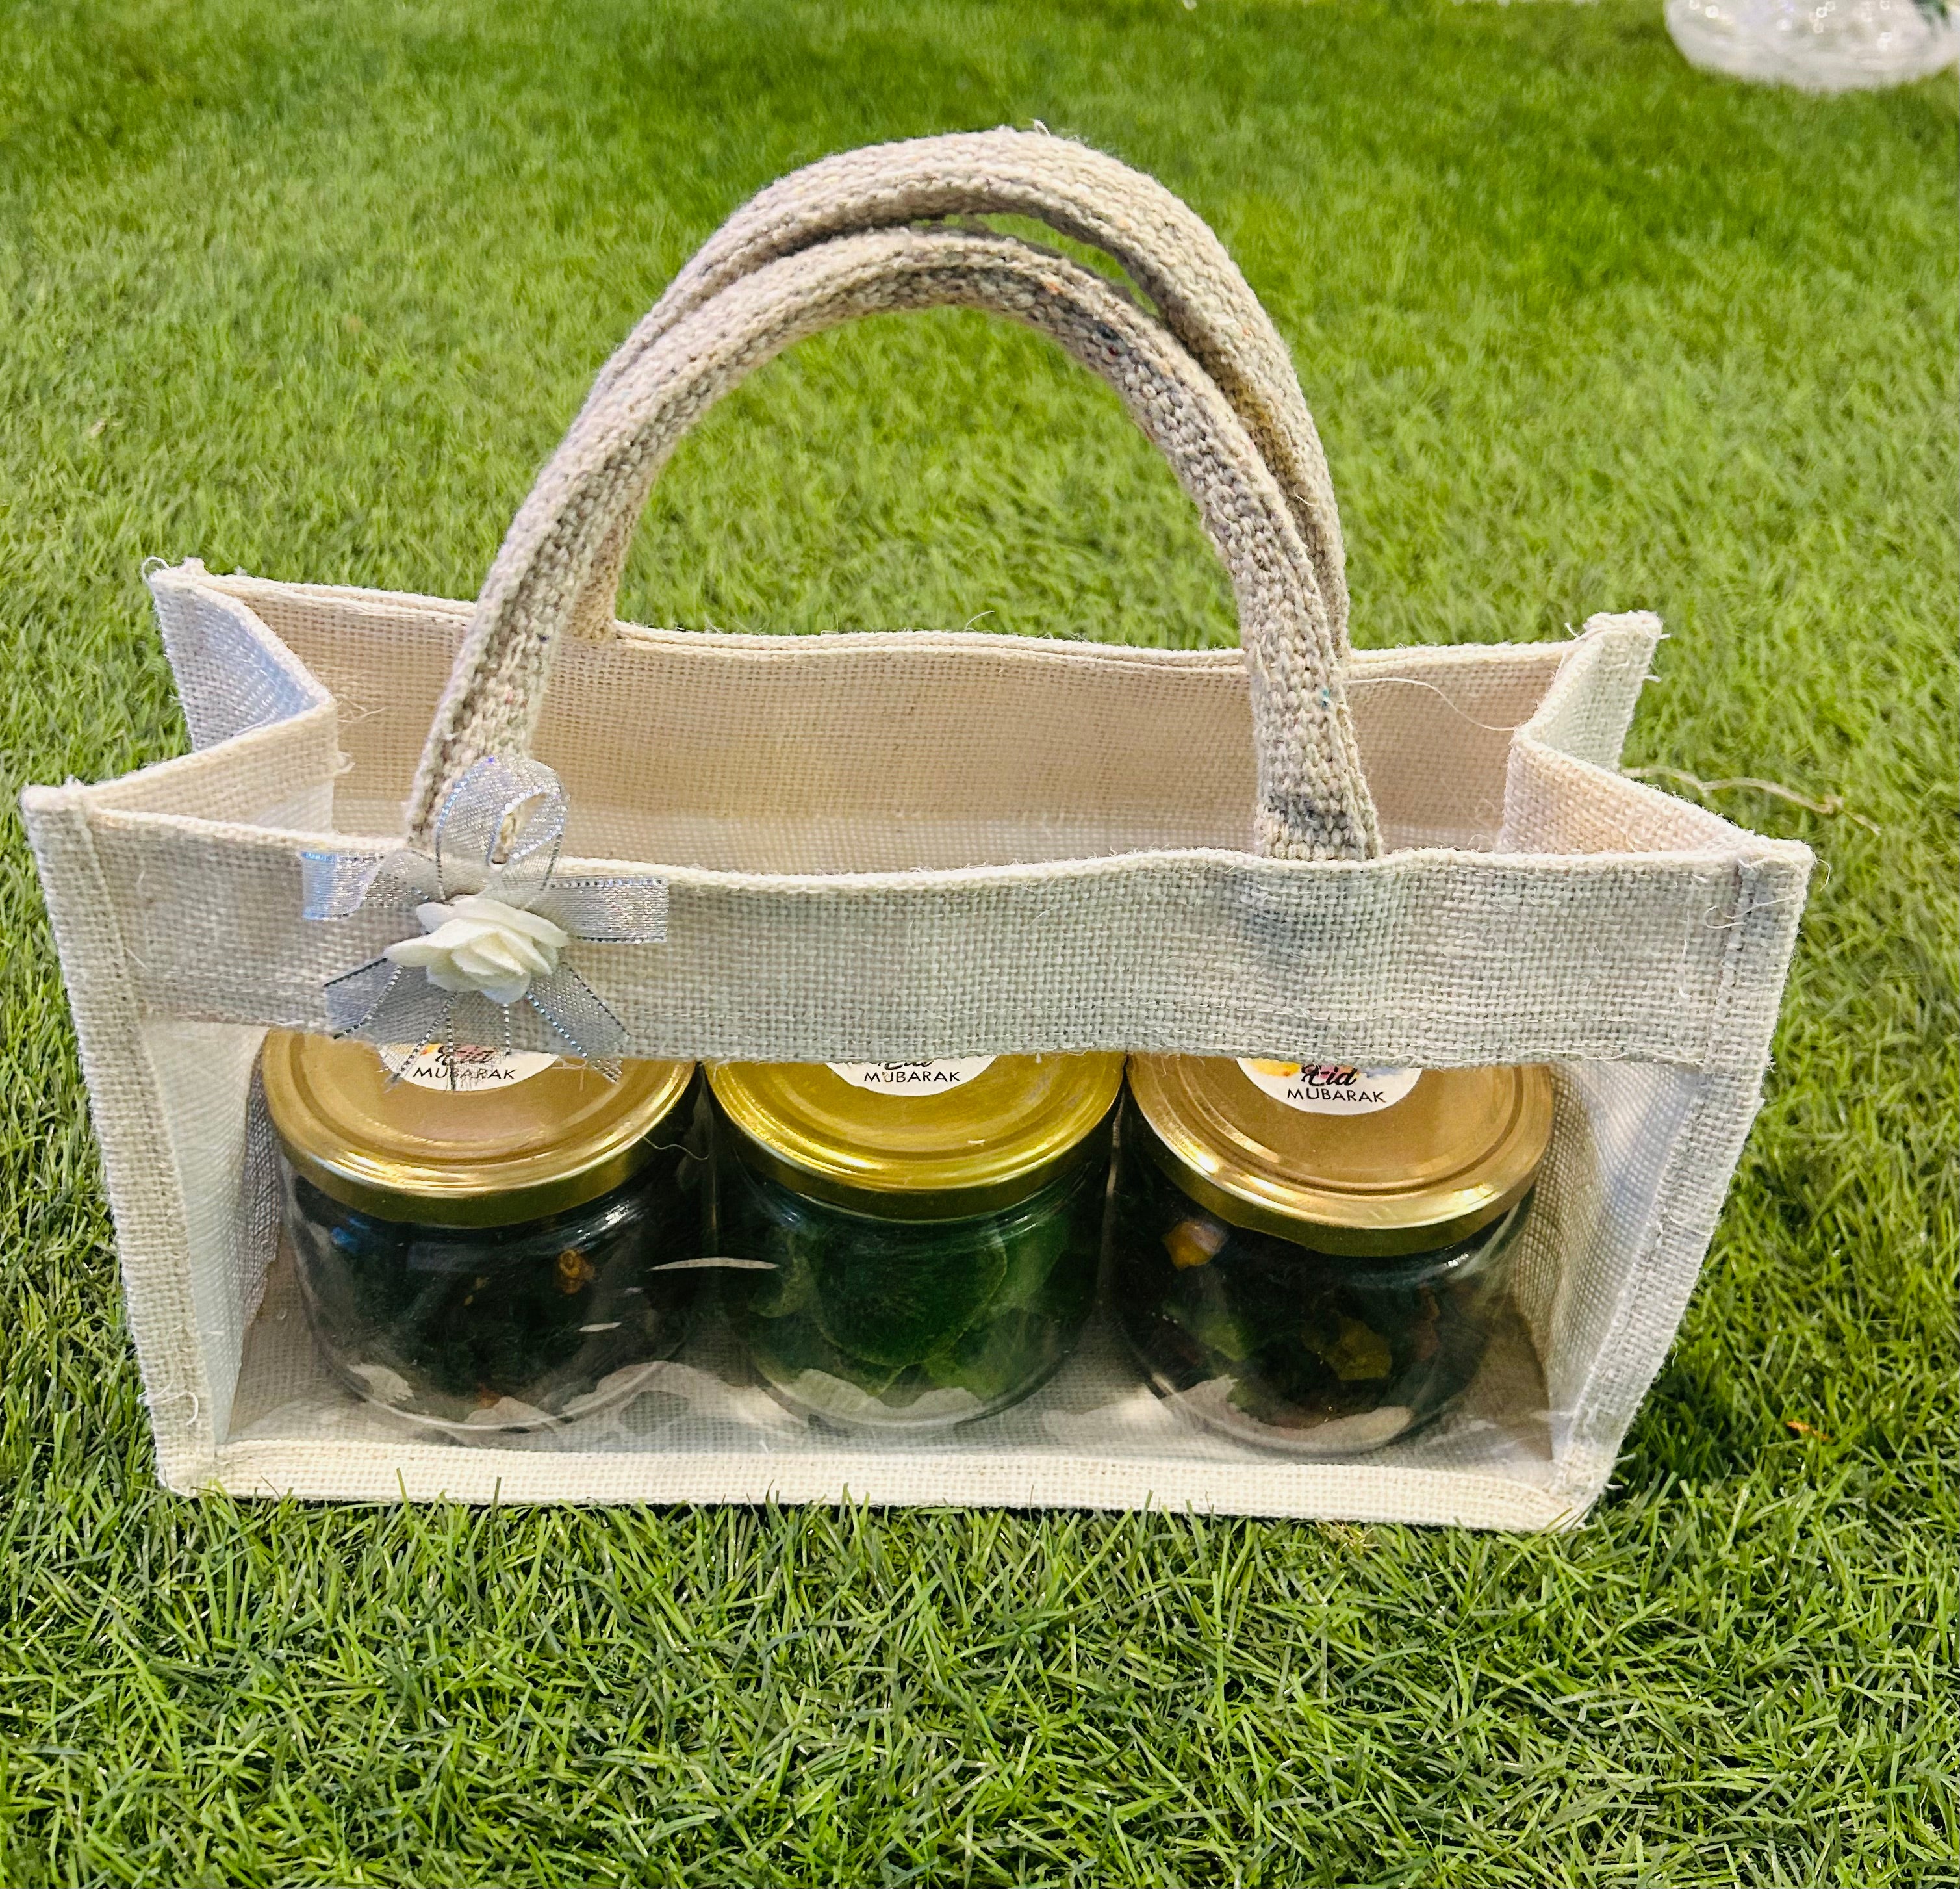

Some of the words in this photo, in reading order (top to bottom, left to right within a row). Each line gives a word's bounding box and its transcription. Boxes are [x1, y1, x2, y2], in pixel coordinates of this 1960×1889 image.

[864, 1071, 960, 1083] MUBARAK
[1301, 1064, 1358, 1086] Eid
[1287, 1087, 1386, 1103] MUBARAK
